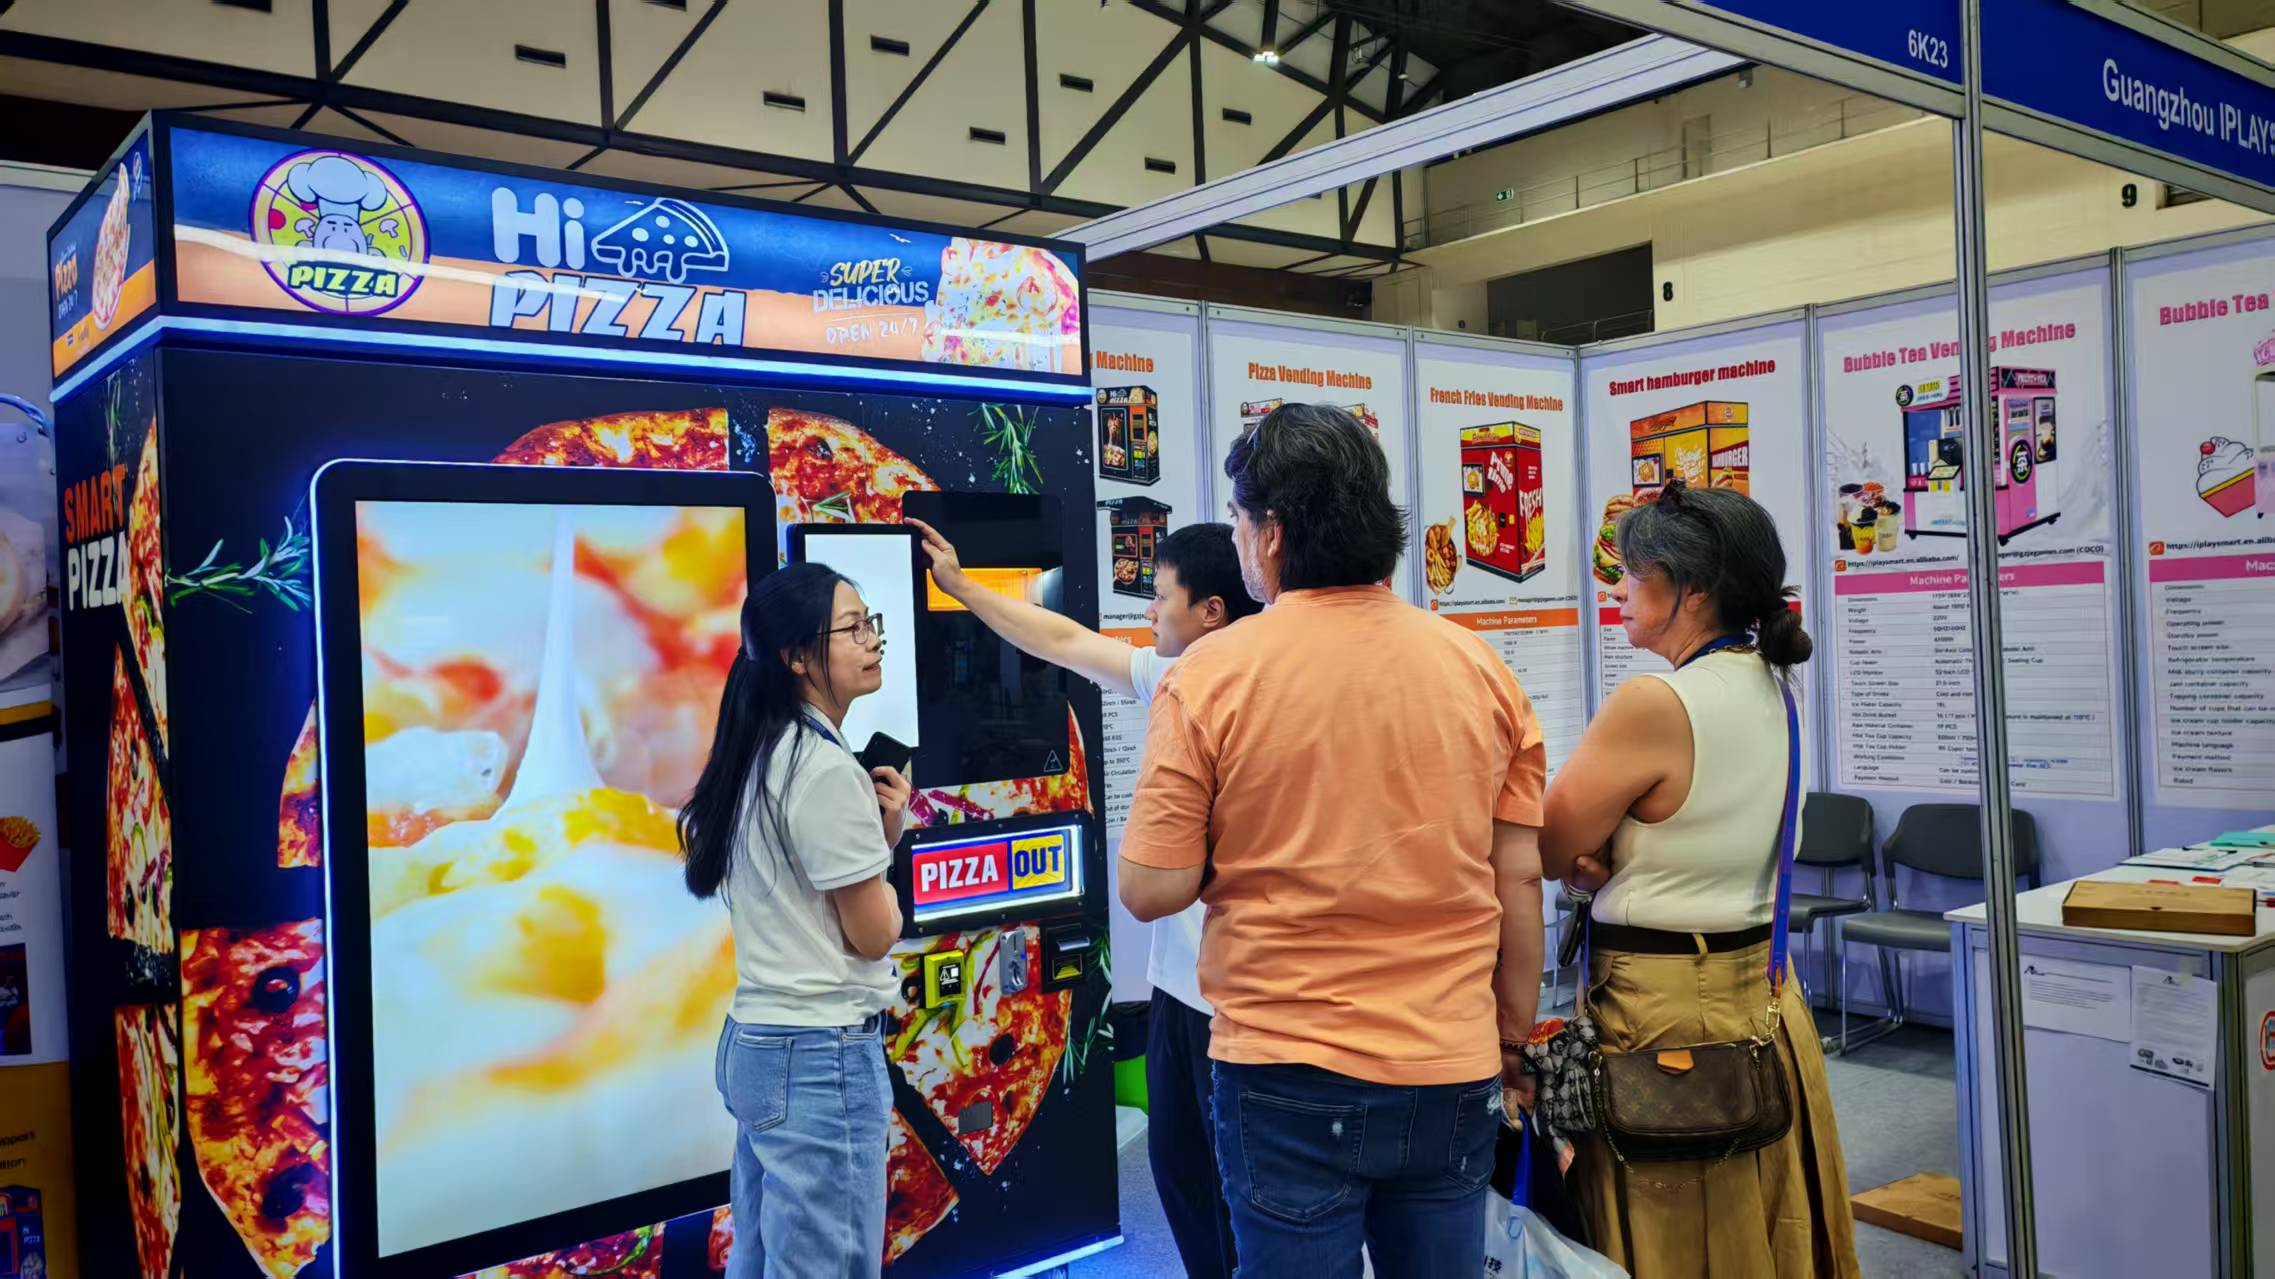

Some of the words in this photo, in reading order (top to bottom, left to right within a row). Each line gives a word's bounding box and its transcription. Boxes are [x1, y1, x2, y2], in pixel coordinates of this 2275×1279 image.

[1908, 28, 1949, 69] 6K23
[2102, 57, 2215, 136] Guangzhou
[2121, 183, 2138, 207] 9
[491, 186, 585, 270] Hi
[289, 263, 398, 297] PIZZA
[830, 257, 900, 286] SUPER
[489, 270, 747, 346] PIZZA
[812, 281, 929, 313] DELICIOUS
[2160, 300, 2228, 325] Bubble
[2232, 294, 2269, 314] Tea
[826, 323, 872, 344] OPEN
[880, 317, 919, 337] 24/7
[1097, 351, 1154, 373] Machine
[1843, 352, 1896, 373] Bubble
[1899, 346, 1927, 364] Tea
[1930, 336, 1996, 358] Veng
[2001, 323, 2076, 349] Machine
[1248, 362, 1276, 381] Pizza
[1278, 364, 1324, 387] Vending
[1326, 370, 1372, 390] Machine
[1609, 378, 1644, 396] Smart
[1646, 367, 1715, 392] hamburger
[1718, 360, 1775, 381] machine
[1430, 387, 1462, 405] French
[1464, 389, 1486, 408] Fries
[1488, 393, 1525, 411] Vending
[1526, 394, 1563, 412] Machine
[64, 463, 126, 544] SMART
[67, 530, 131, 612] PIZZA
[1909, 575, 1952, 585] Machine
[1476, 617, 1502, 625] Machine
[1503, 616, 1537, 625] Parameters
[920, 854, 999, 893] PIZZA
[1014, 846, 1062, 878] OUT
